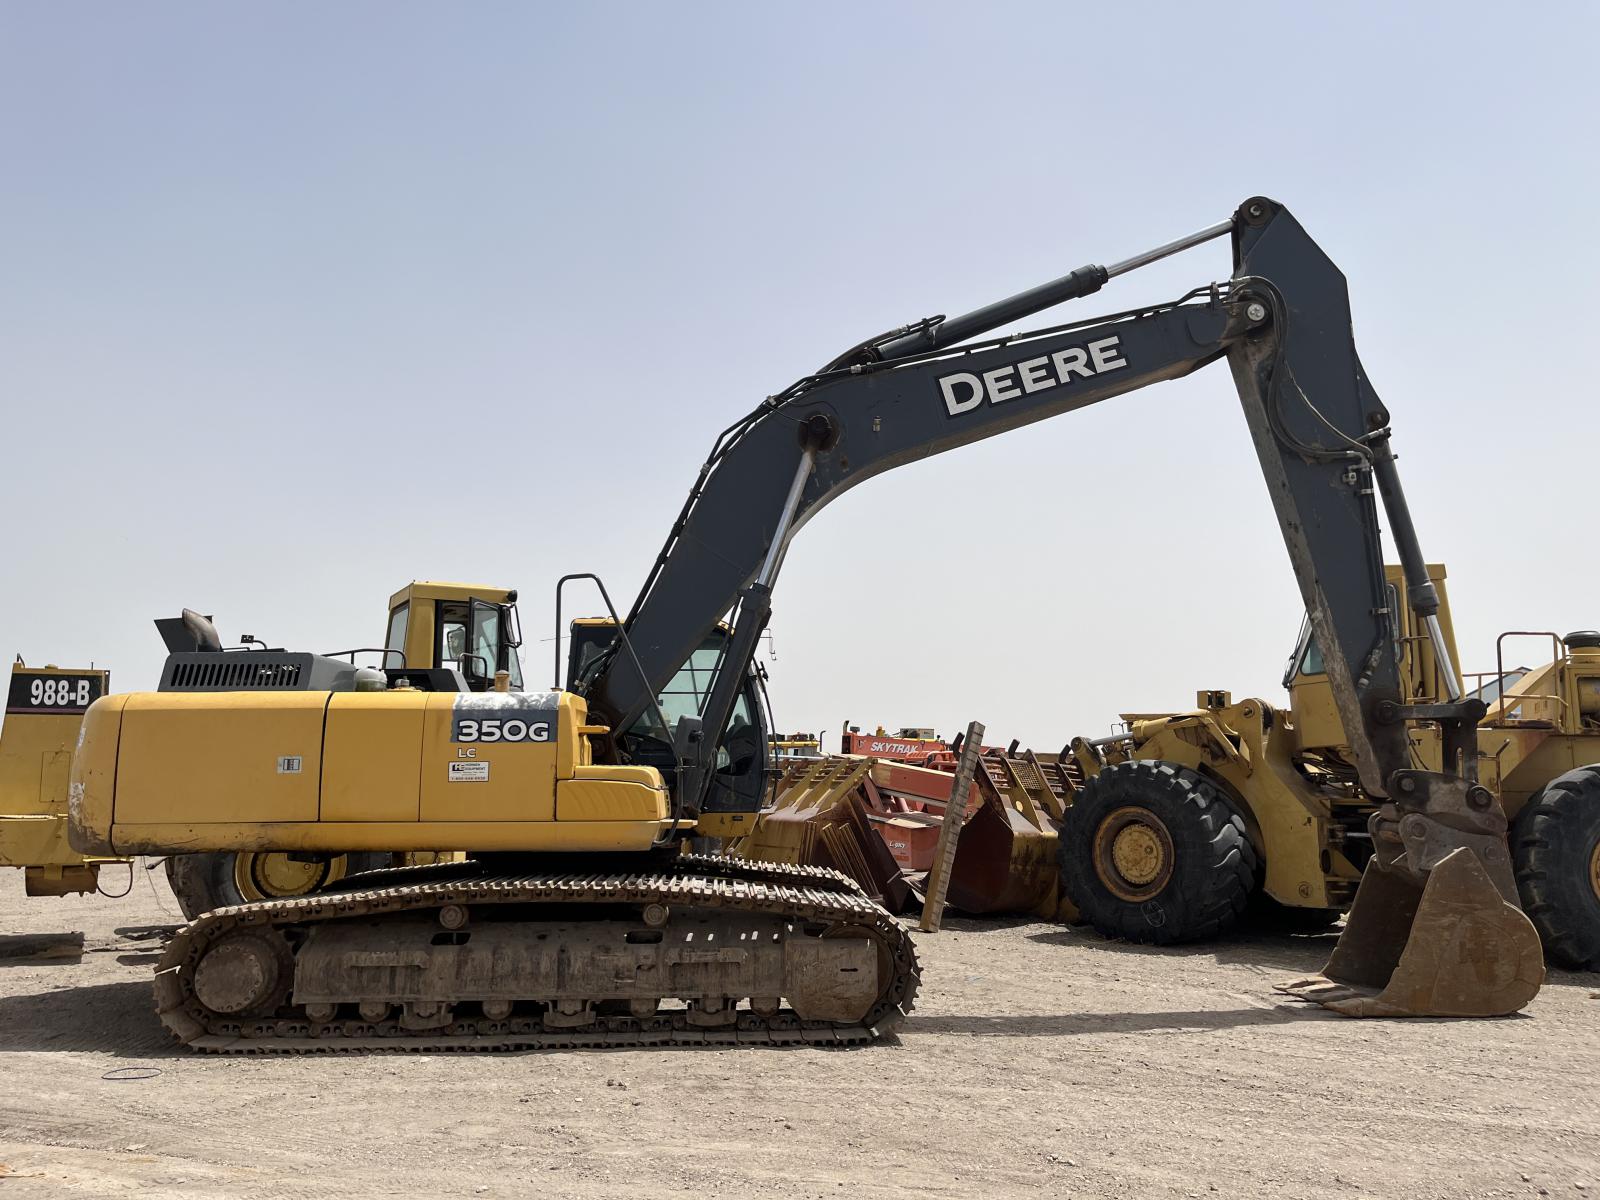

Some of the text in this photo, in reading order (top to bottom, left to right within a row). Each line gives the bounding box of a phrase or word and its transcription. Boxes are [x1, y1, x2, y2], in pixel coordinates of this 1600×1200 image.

[938, 335, 1127, 416] DEERE
[30, 679, 90, 706] 988-B
[458, 719, 549, 742] 350G
[458, 748, 477, 758] LC
[870, 741, 918, 754] SKYTRAK
